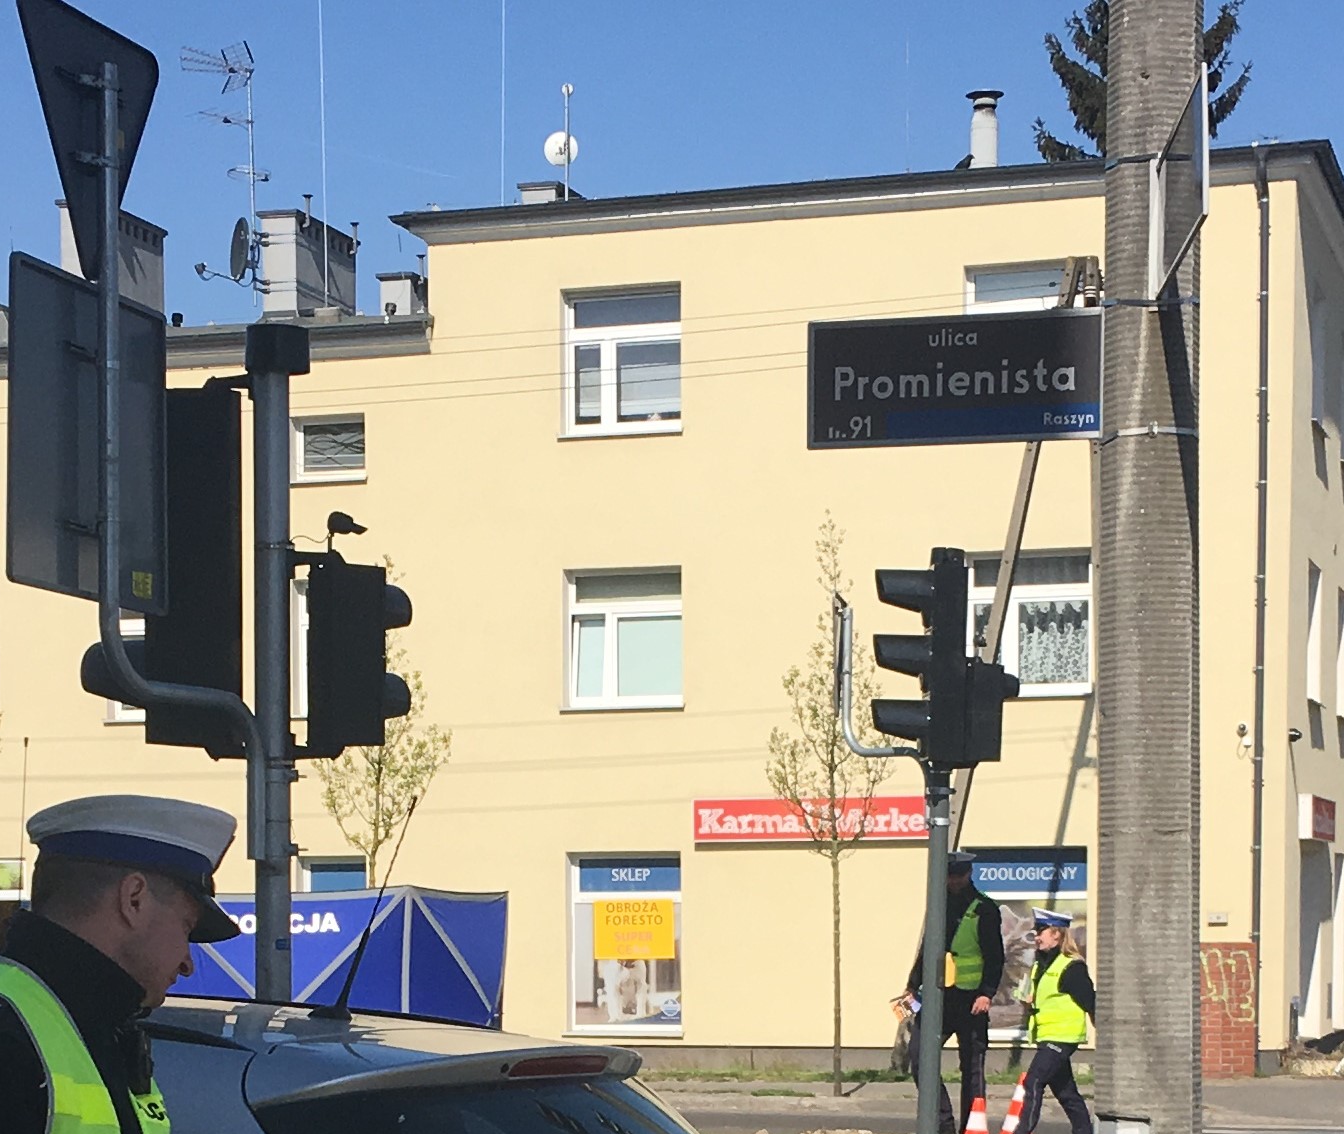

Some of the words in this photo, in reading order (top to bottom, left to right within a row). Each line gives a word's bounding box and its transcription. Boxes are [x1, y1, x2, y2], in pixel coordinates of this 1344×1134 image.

[928, 329, 978, 347] ulica
[834, 358, 1075, 401] Promienista
[850, 415, 873, 439] 91
[1043, 411, 1095, 427] Raszyn
[698, 808, 799, 834] Karma
[611, 868, 650, 881] SKLEP
[979, 867, 1077, 880] ZOOLOGICZNY
[606, 900, 659, 913] OBROŻA
[606, 915, 663, 925] FORESTO
